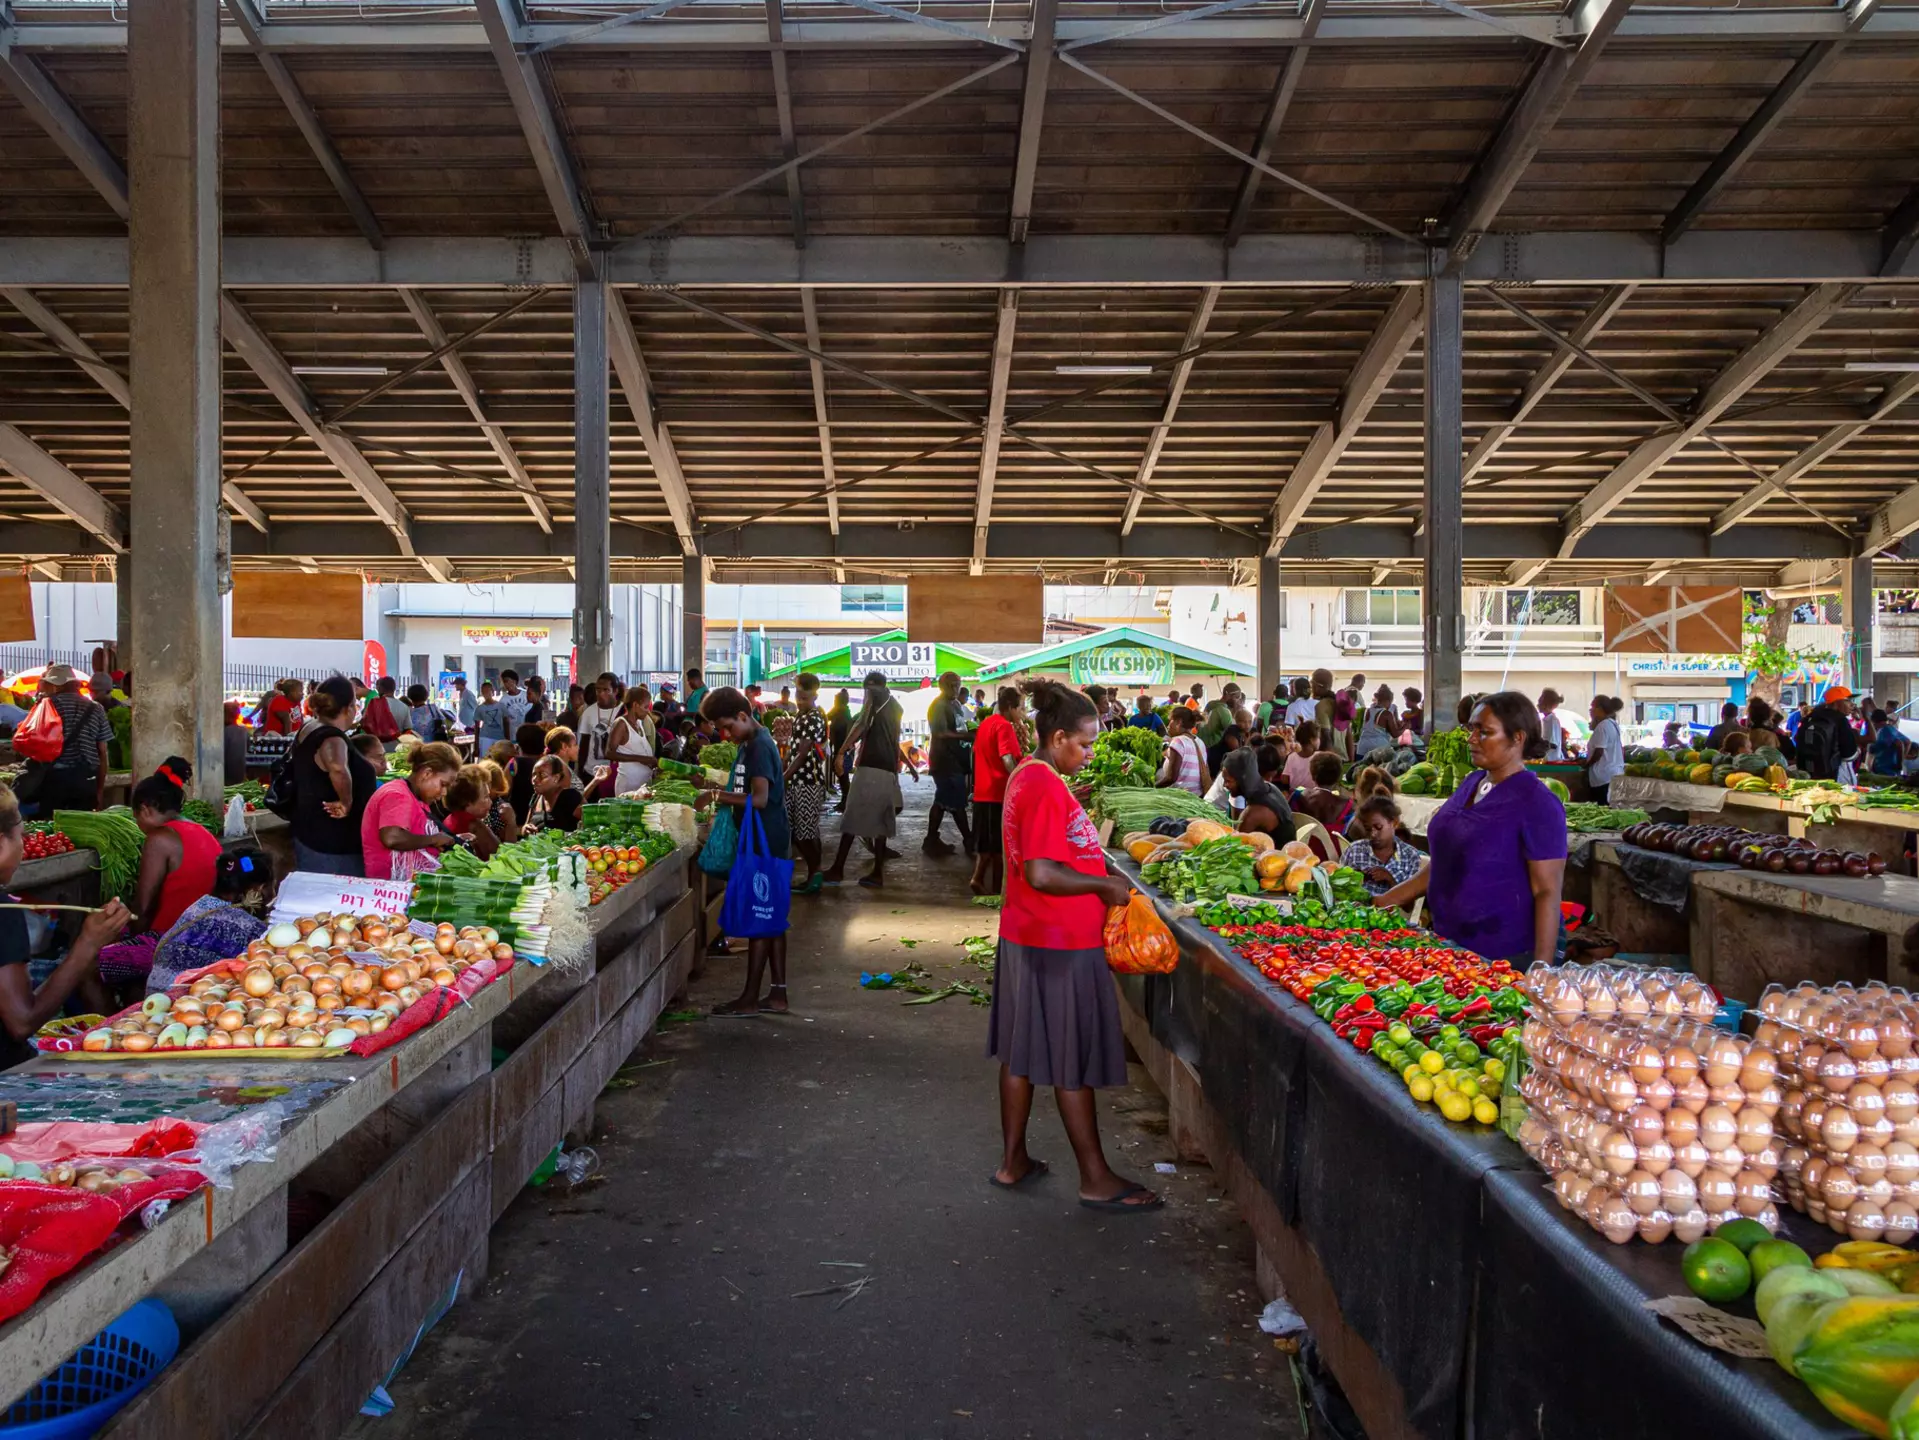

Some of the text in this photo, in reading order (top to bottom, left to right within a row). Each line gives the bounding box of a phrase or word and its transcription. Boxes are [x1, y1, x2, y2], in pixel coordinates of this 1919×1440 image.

[464, 629, 490, 637] LOW
[493, 630, 519, 638] LOW
[856, 645, 930, 662] PRO 31
[1078, 656, 1167, 671] BULK SHOP
[1632, 659, 1679, 670] CHRISTIN
[1681, 663, 1709, 671] SUPER
[856, 666, 930, 676] MARKET PRO
[337, 893, 397, 914] Pty. Ltd.
